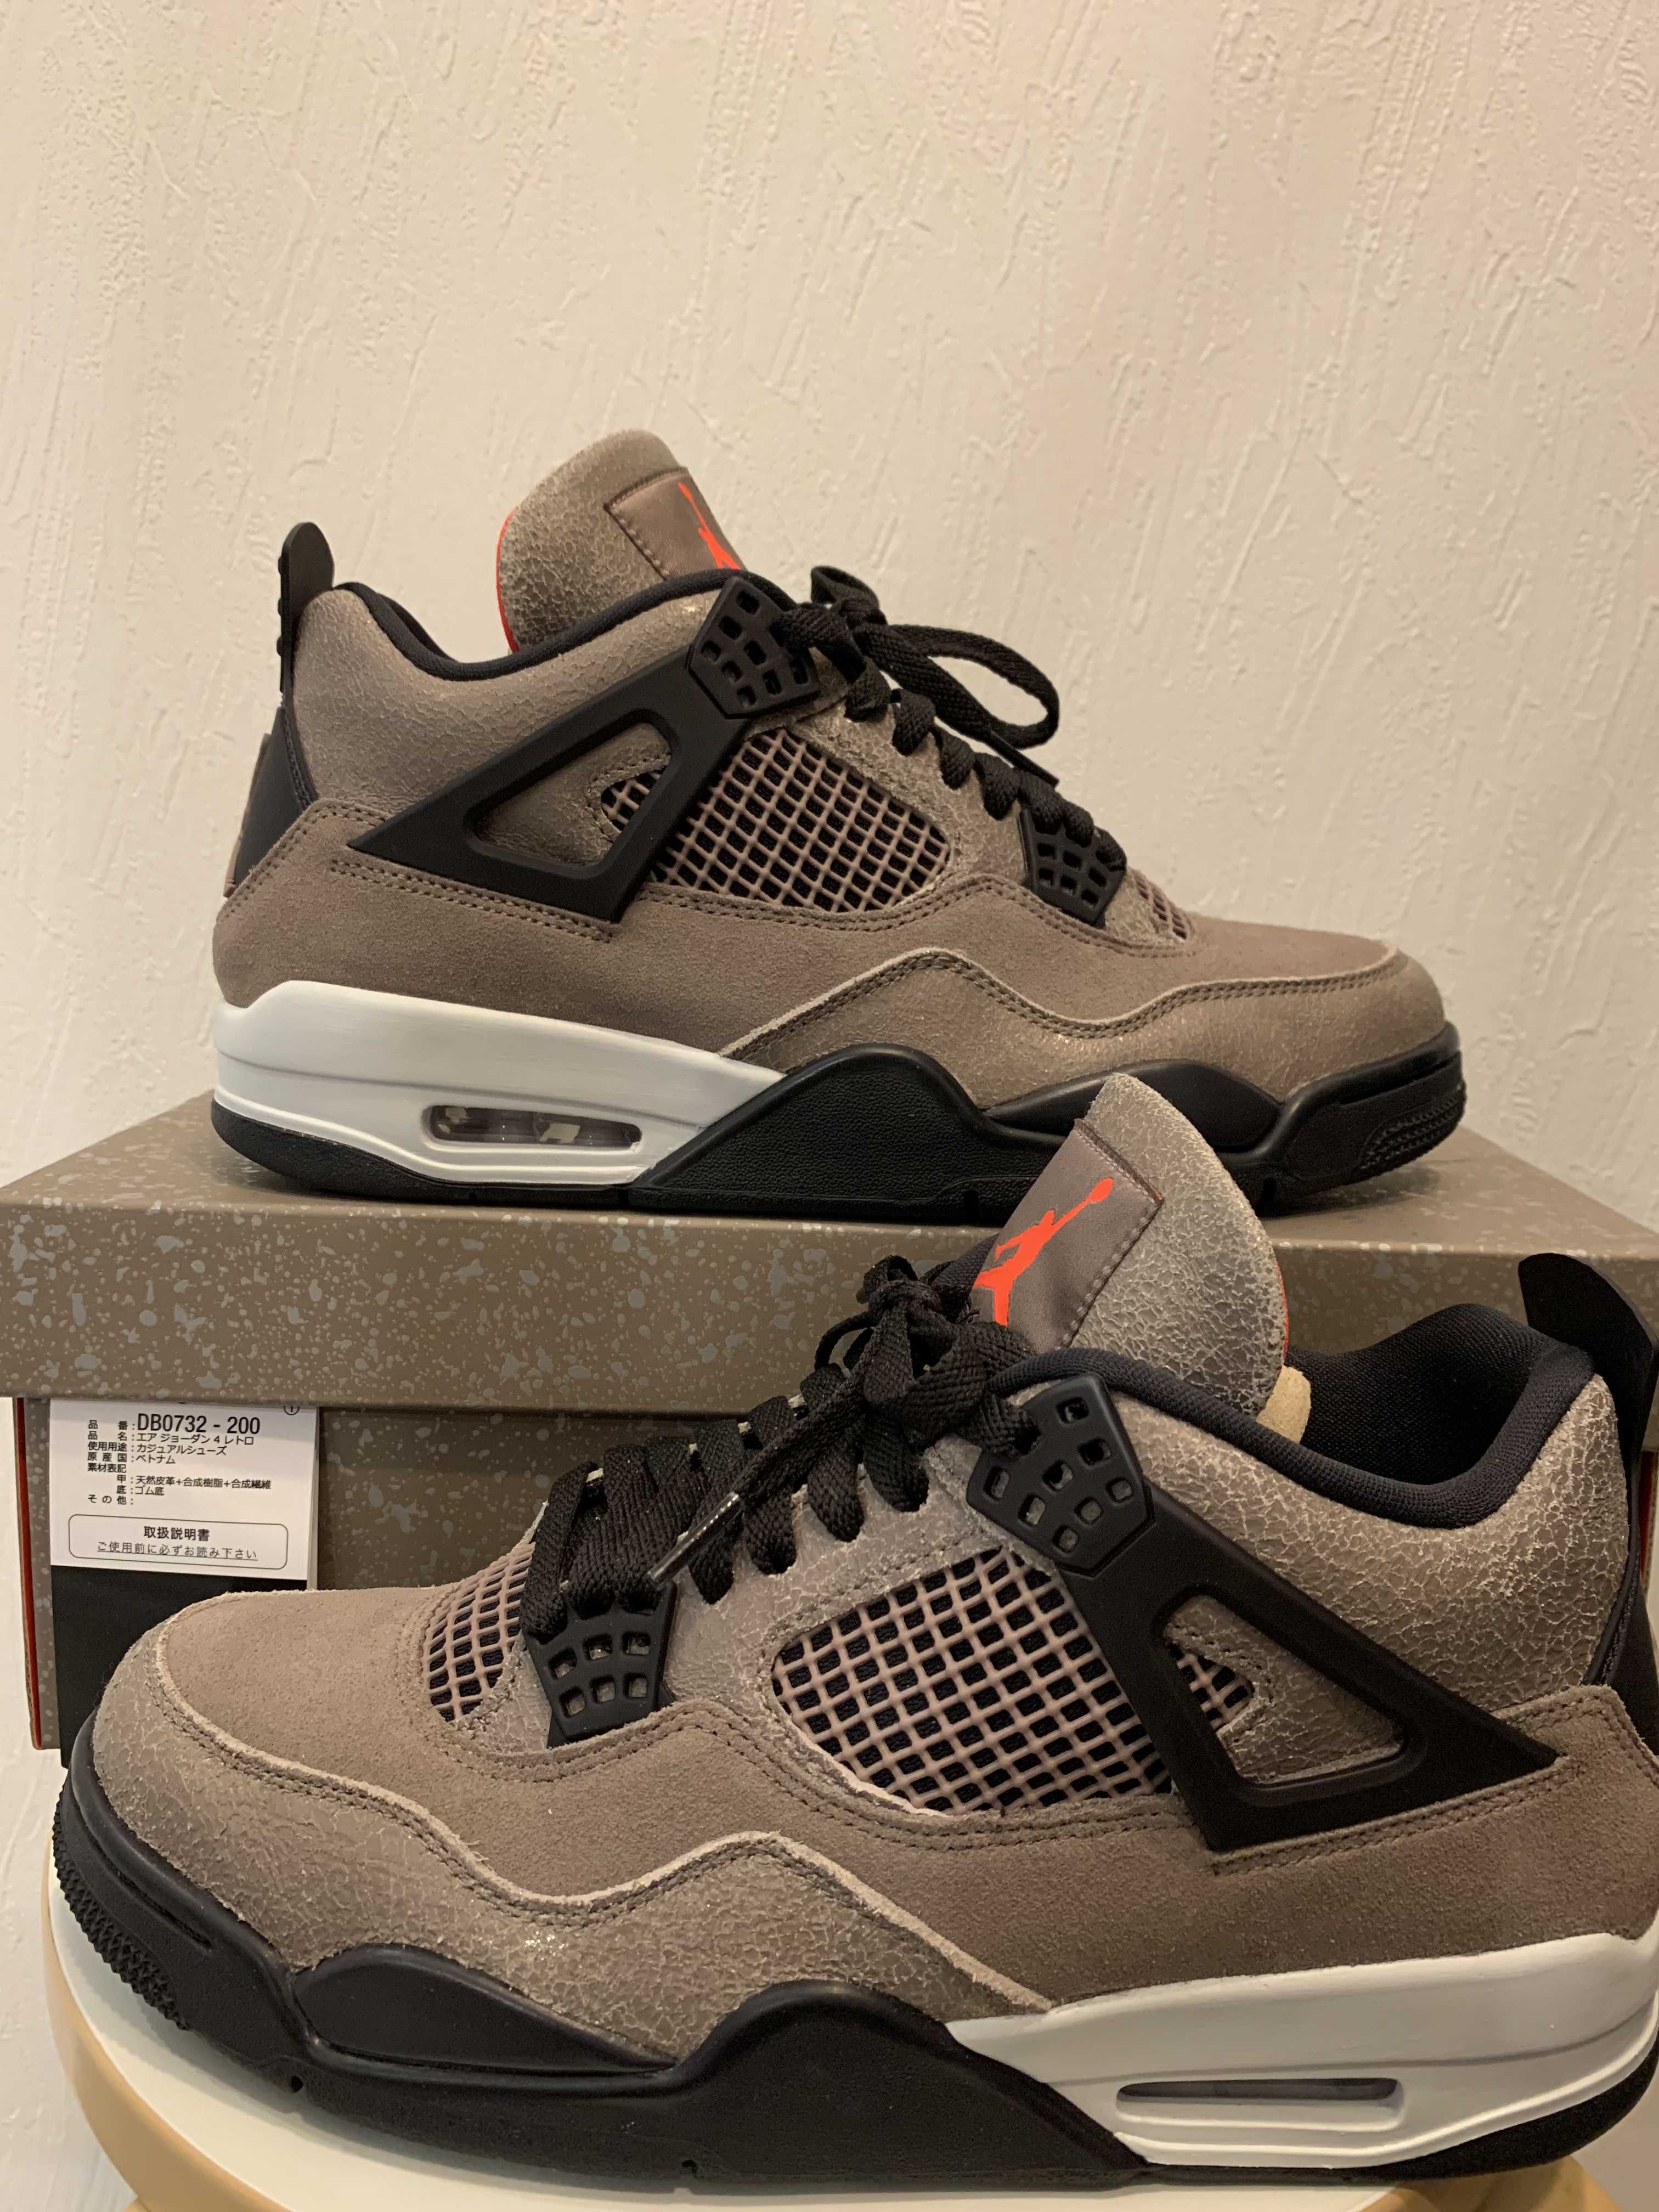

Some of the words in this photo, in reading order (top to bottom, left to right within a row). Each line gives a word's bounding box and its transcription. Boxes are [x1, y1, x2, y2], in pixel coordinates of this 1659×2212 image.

[138, 1413, 207, 1432] DB0732
[227, 1417, 261, 1434] 200
[137, 1433, 157, 1442] エア
[161, 1433, 210, 1444] ジョーダン
[213, 1435, 220, 1443] 4
[224, 1435, 254, 1445] レトロ
[87, 1463, 127, 1474] 素材表記
[144, 1526, 210, 1541] 取扱説明書
[97, 1541, 257, 1559] ご使用前に必ずお読み下さい
